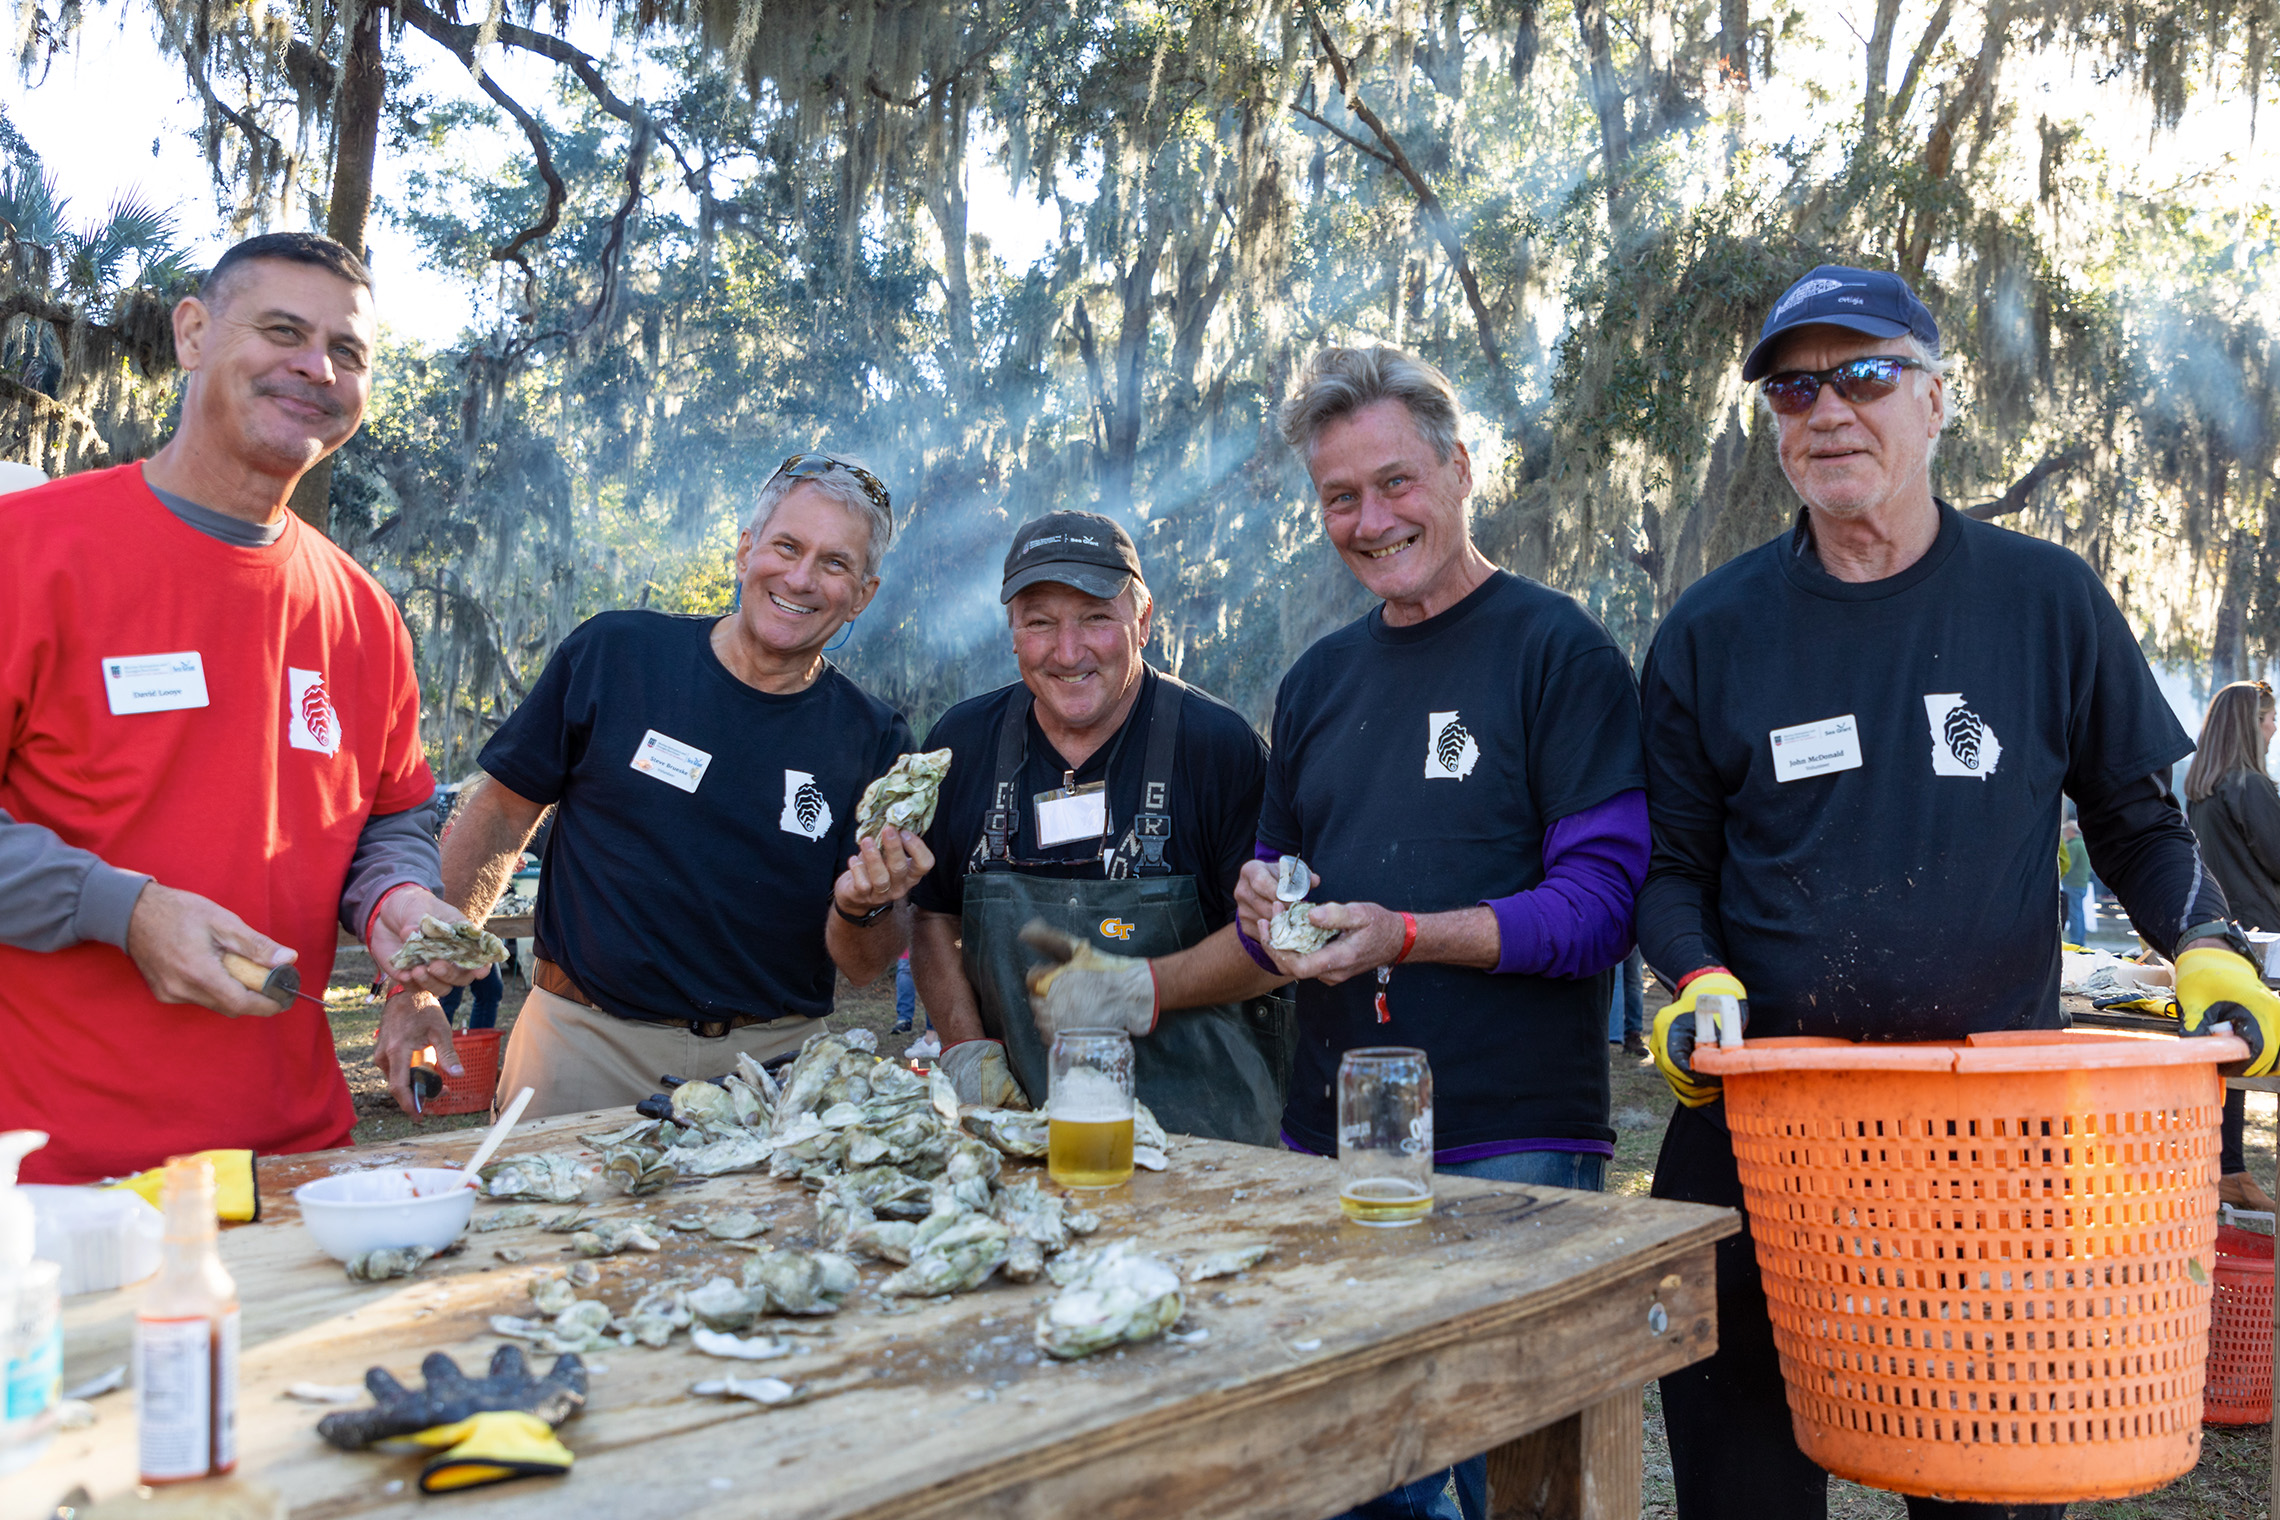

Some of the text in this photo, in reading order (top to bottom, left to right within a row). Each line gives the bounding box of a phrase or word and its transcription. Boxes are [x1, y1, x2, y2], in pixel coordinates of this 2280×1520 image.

[650, 756, 665, 767] Steve
[1789, 750, 1844, 767] John McDonald
[1100, 918, 1135, 941] GT
